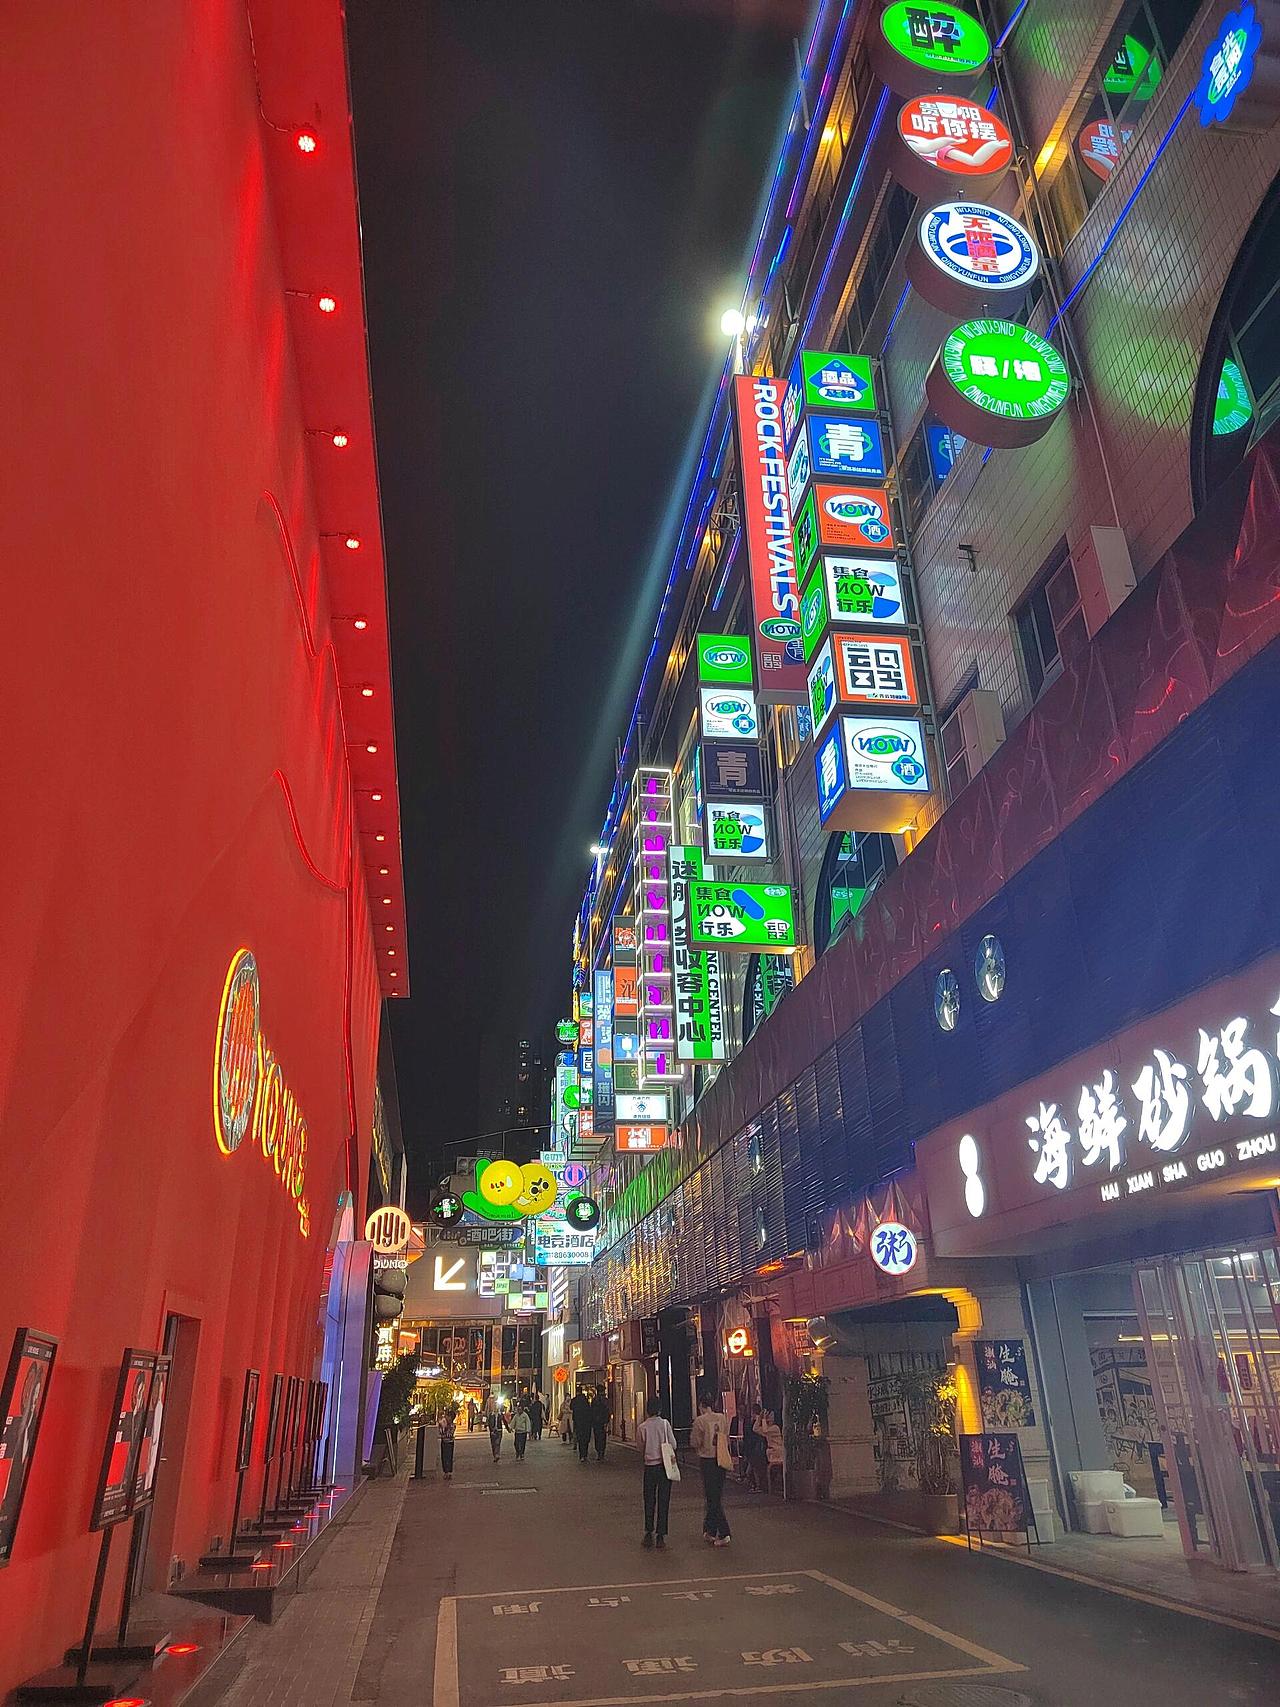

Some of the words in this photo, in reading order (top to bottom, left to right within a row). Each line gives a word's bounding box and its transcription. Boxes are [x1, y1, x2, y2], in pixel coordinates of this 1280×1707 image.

[910, 113, 998, 141] 听你摆
[941, 256, 990, 283] QINGYUNFUN
[963, 384, 1024, 418] QINGYUNFUN
[753, 384, 782, 453] ROCK
[824, 423, 865, 461] 青
[759, 456, 799, 613] FESTIVALS
[867, 524, 881, 537] 酒
[832, 565, 870, 581] 集食
[836, 599, 873, 614] 行乐
[716, 751, 748, 786] 青
[899, 763, 915, 776] 酒
[711, 810, 742, 822] 集食
[713, 837, 743, 850] 行乐
[696, 886, 732, 901] 集食
[697, 921, 734, 936] 行乐
[708, 978, 722, 1041] CENTER
[1025, 990, 1280, 1190] 海鲜砂锅
[1101, 1182, 1120, 1202] HAI
[1126, 1171, 1154, 1194] XIAN
[1162, 1161, 1188, 1183] SHA
[1196, 1149, 1225, 1172] GUO
[1236, 1132, 1277, 1161] ZHOU
[466, 1228, 513, 1242] 酒吧街
[537, 1234, 594, 1249] 电竞酒店
[875, 1229, 914, 1266] 粥
[497, 1638, 916, 1686] 消防通道
